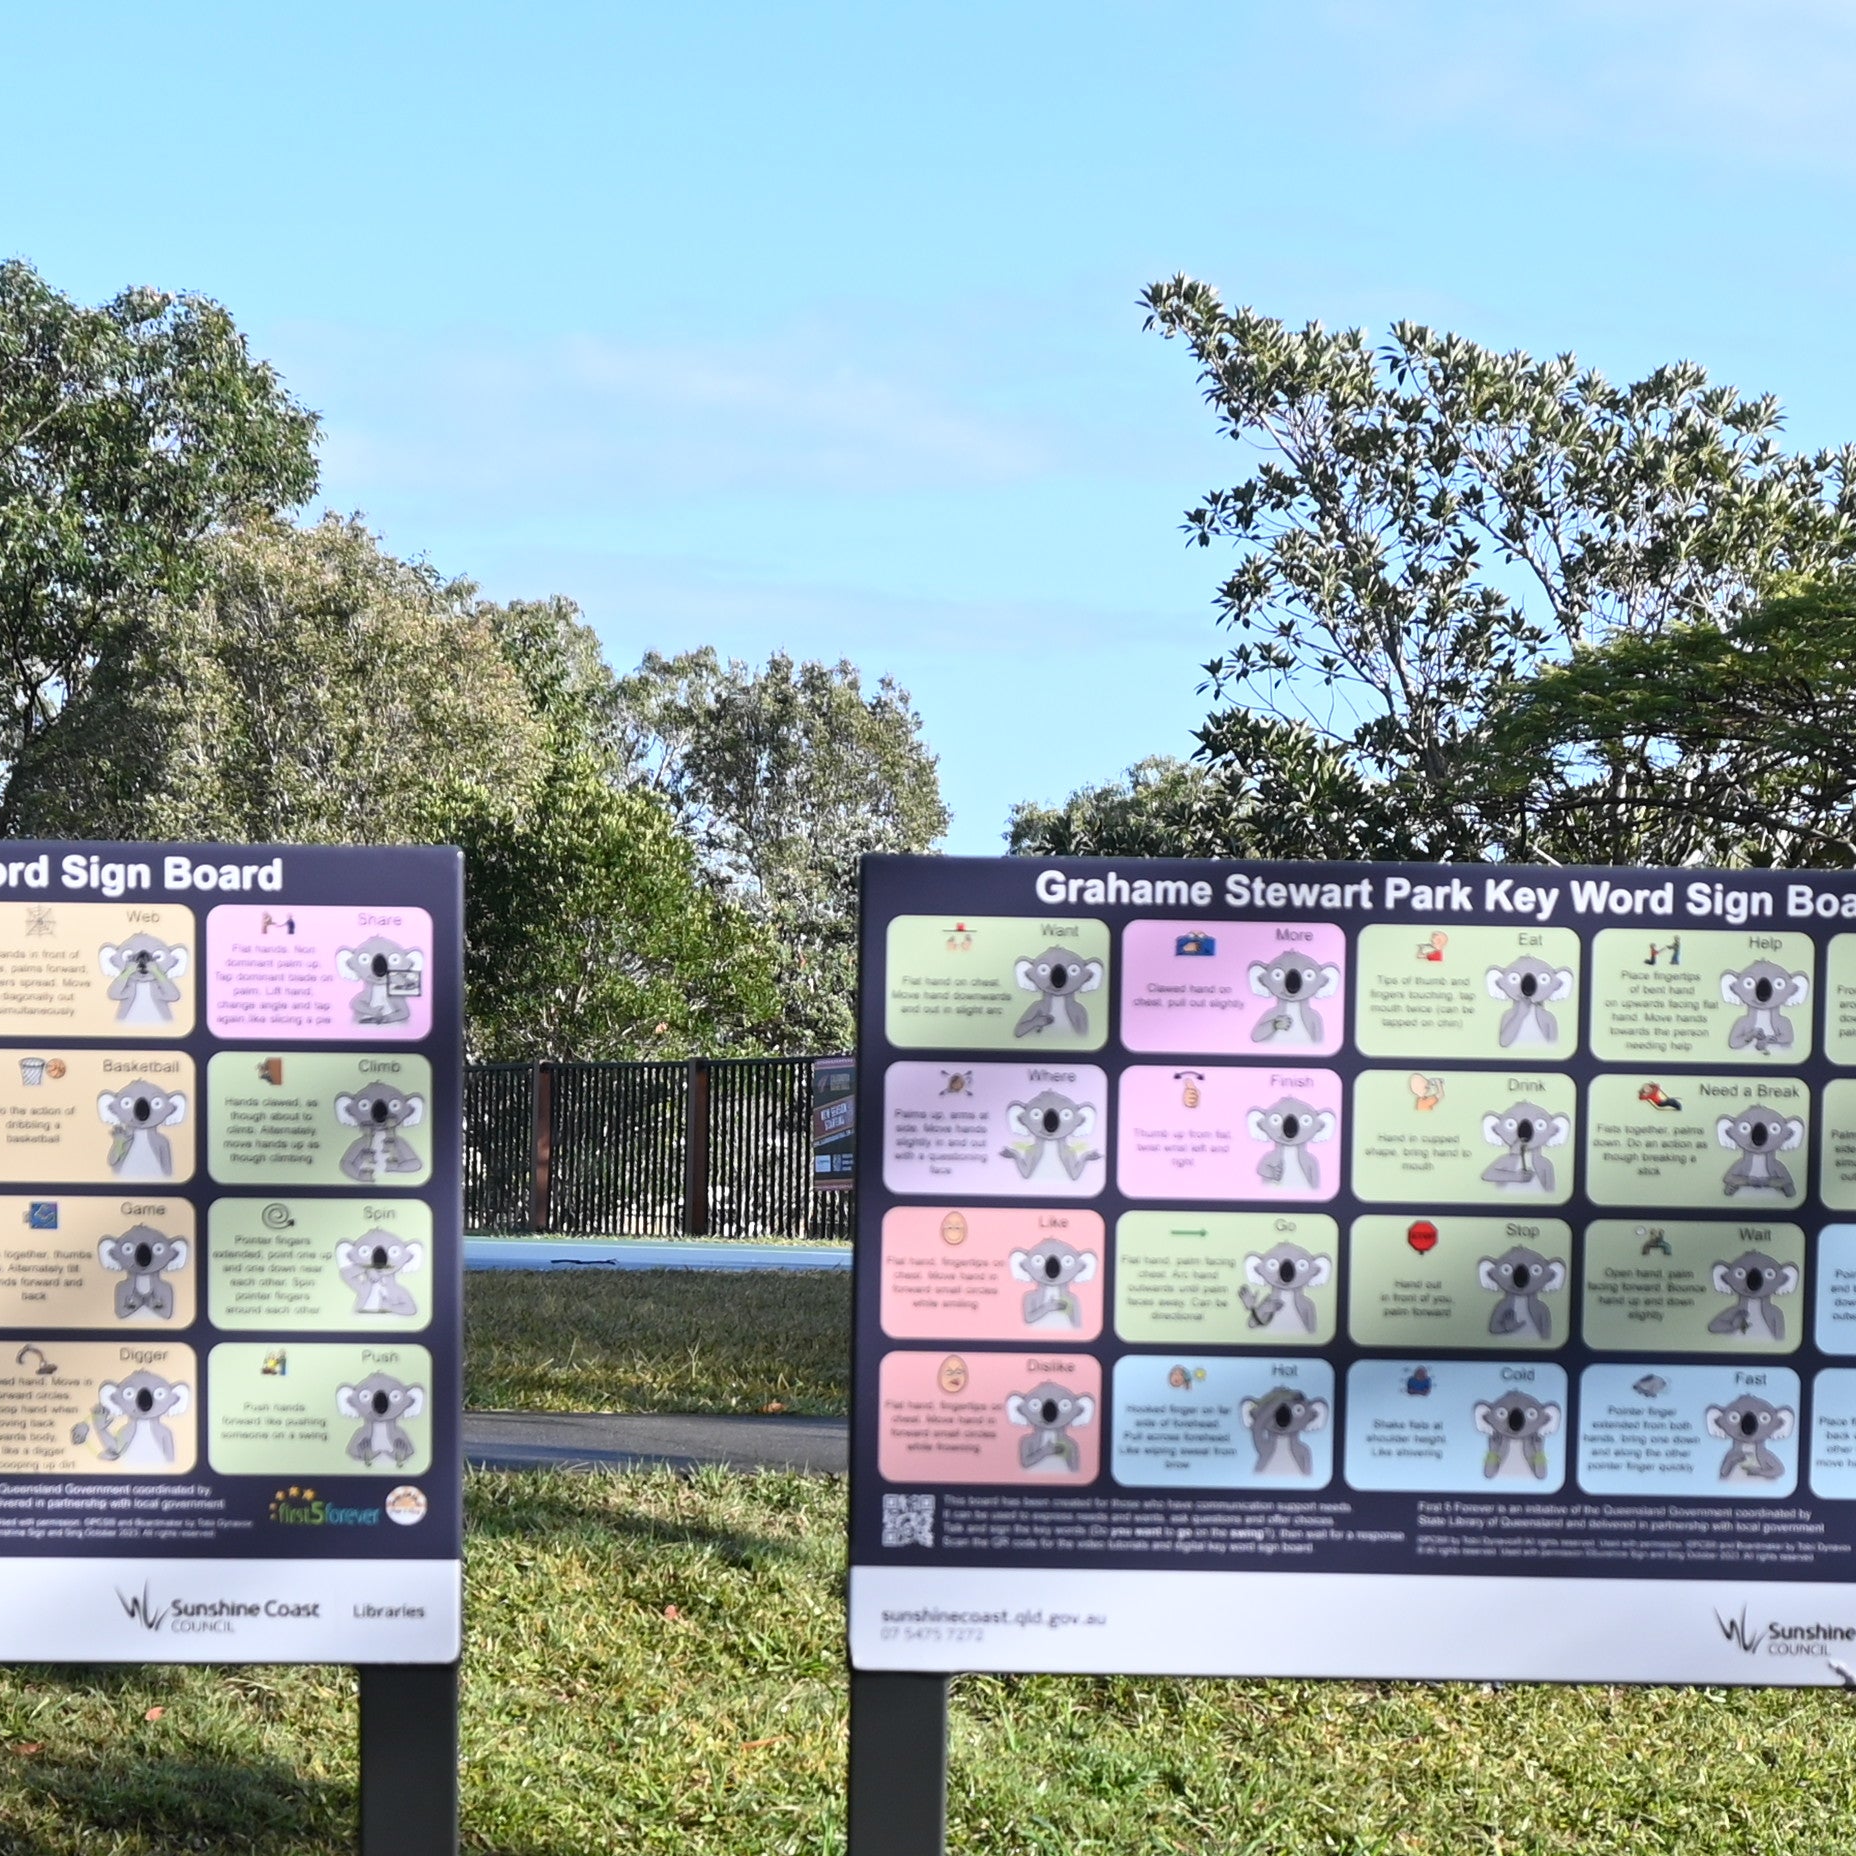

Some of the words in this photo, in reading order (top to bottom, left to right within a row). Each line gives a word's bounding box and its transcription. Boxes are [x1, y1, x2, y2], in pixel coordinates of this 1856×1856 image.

[61, 854, 151, 897] Sign
[164, 856, 283, 891] Board
[1036, 869, 1212, 905] Grahame
[1225, 873, 1373, 909] Stewart
[1385, 877, 1473, 910] Park
[1485, 878, 1560, 921] Key
[1570, 880, 1674, 915] Word
[1686, 882, 1773, 924] Sign
[127, 910, 160, 923] Web
[359, 913, 402, 926] Share
[1041, 924, 1079, 937] Want
[1275, 928, 1314, 942] More
[1518, 932, 1543, 946] Eat
[1749, 936, 1783, 952] Help
[103, 1059, 180, 1073] Basketball
[358, 1059, 402, 1074] Climb
[1029, 1069, 1077, 1083] Where
[1270, 1074, 1314, 1088] Finish
[1507, 1078, 1546, 1092] Drink
[1699, 1083, 1738, 1097] Need
[1757, 1084, 1800, 1098] Break
[120, 1201, 166, 1216] Game
[363, 1205, 396, 1222] Spin
[1038, 1216, 1069, 1229] Like
[1274, 1218, 1297, 1232] Go
[1506, 1223, 1540, 1240] Stop
[1739, 1228, 1771, 1242] Wait
[119, 1347, 168, 1364] Digger
[361, 1349, 400, 1364] Push
[1026, 1359, 1075, 1373] Dislike
[1271, 1364, 1298, 1378] Hot
[1500, 1367, 1535, 1382] Cold
[1734, 1371, 1767, 1386] Fast
[171, 1599, 261, 1617] Sunshine
[264, 1599, 320, 1618] Coast
[353, 1604, 425, 1619] Libraries
[881, 1607, 1106, 1629] sunshinecoast.qld.gov.au
[171, 1620, 234, 1633] COUNCIL
[1768, 1622, 1856, 1641] Sunshine
[880, 1627, 899, 1641] 07
[904, 1627, 942, 1641] 5475
[948, 1628, 983, 1642] 7272
[1768, 1643, 1829, 1657] COUNCIL
